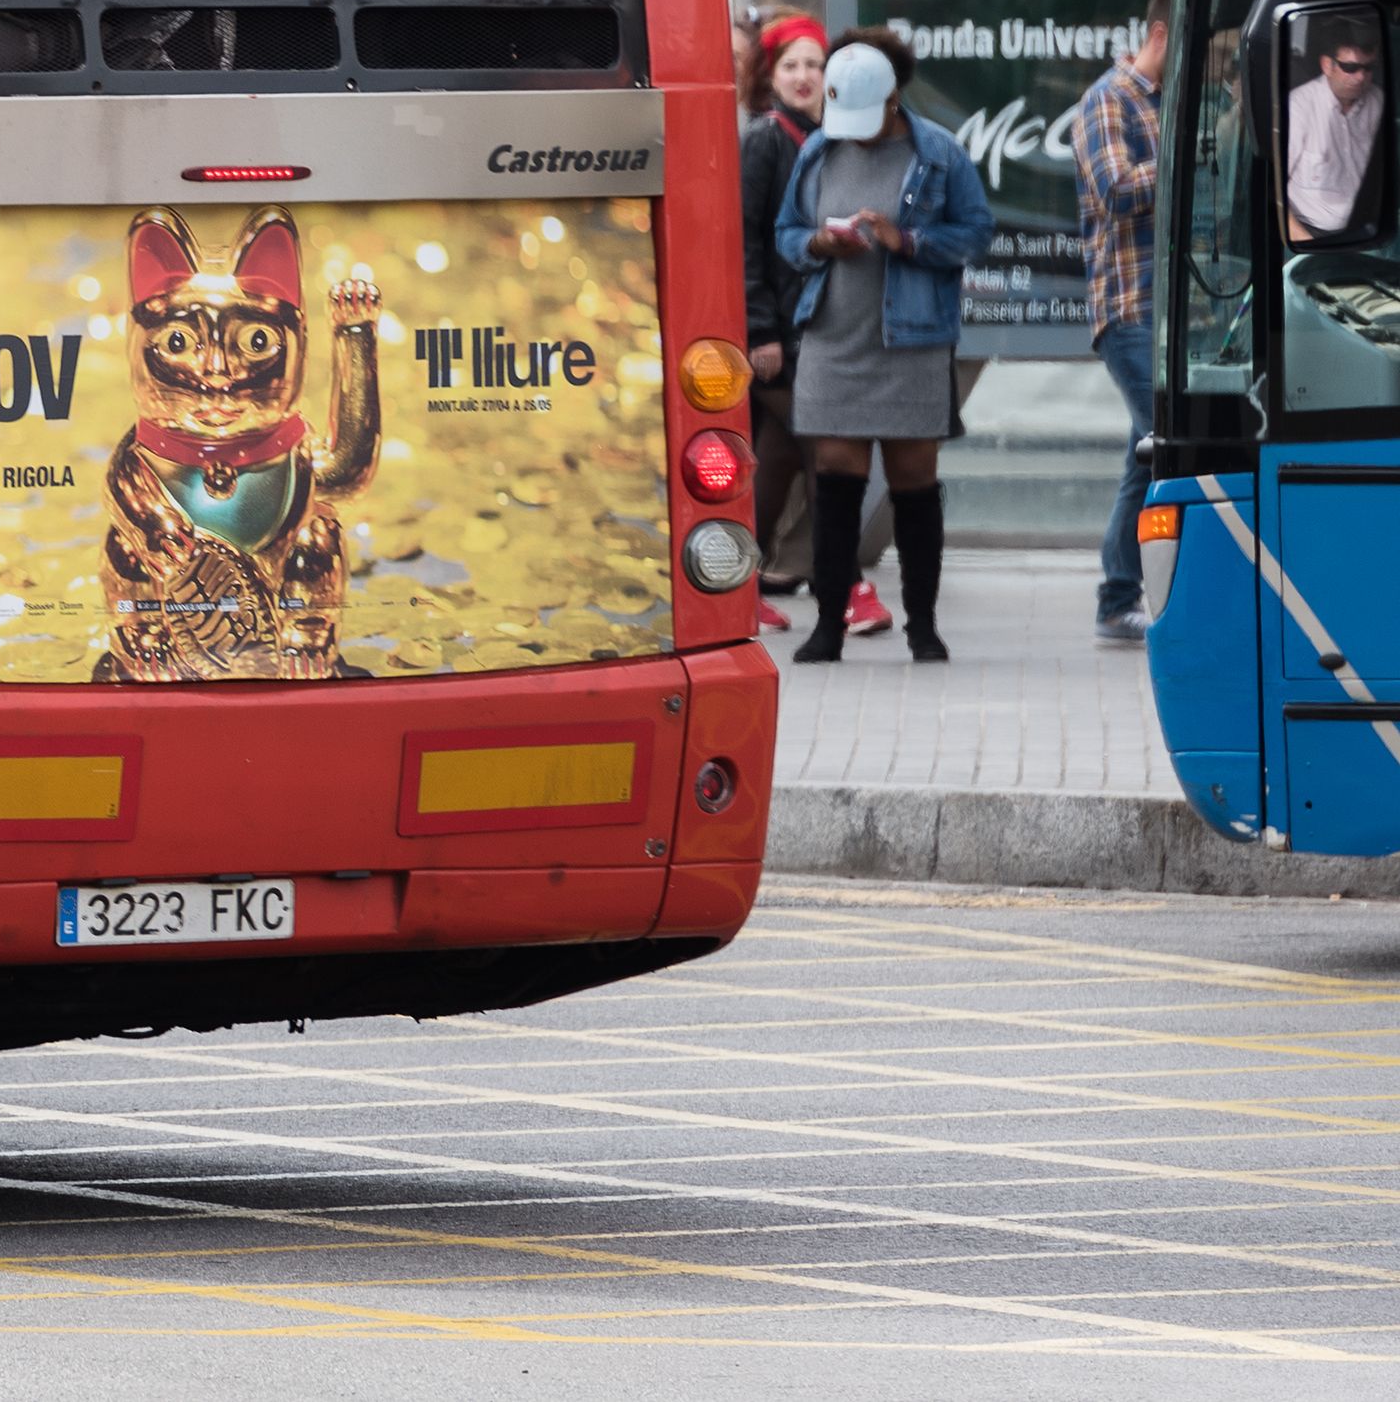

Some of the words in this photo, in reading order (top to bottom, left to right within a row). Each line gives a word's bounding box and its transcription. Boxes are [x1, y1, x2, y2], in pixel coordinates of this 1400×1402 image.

[487, 144, 650, 174] Castrosua
[3, 465, 75, 488] RIGOLA
[64, 921, 74, 935] E
[87, 892, 186, 936] 3223
[210, 886, 284, 933] FKC
